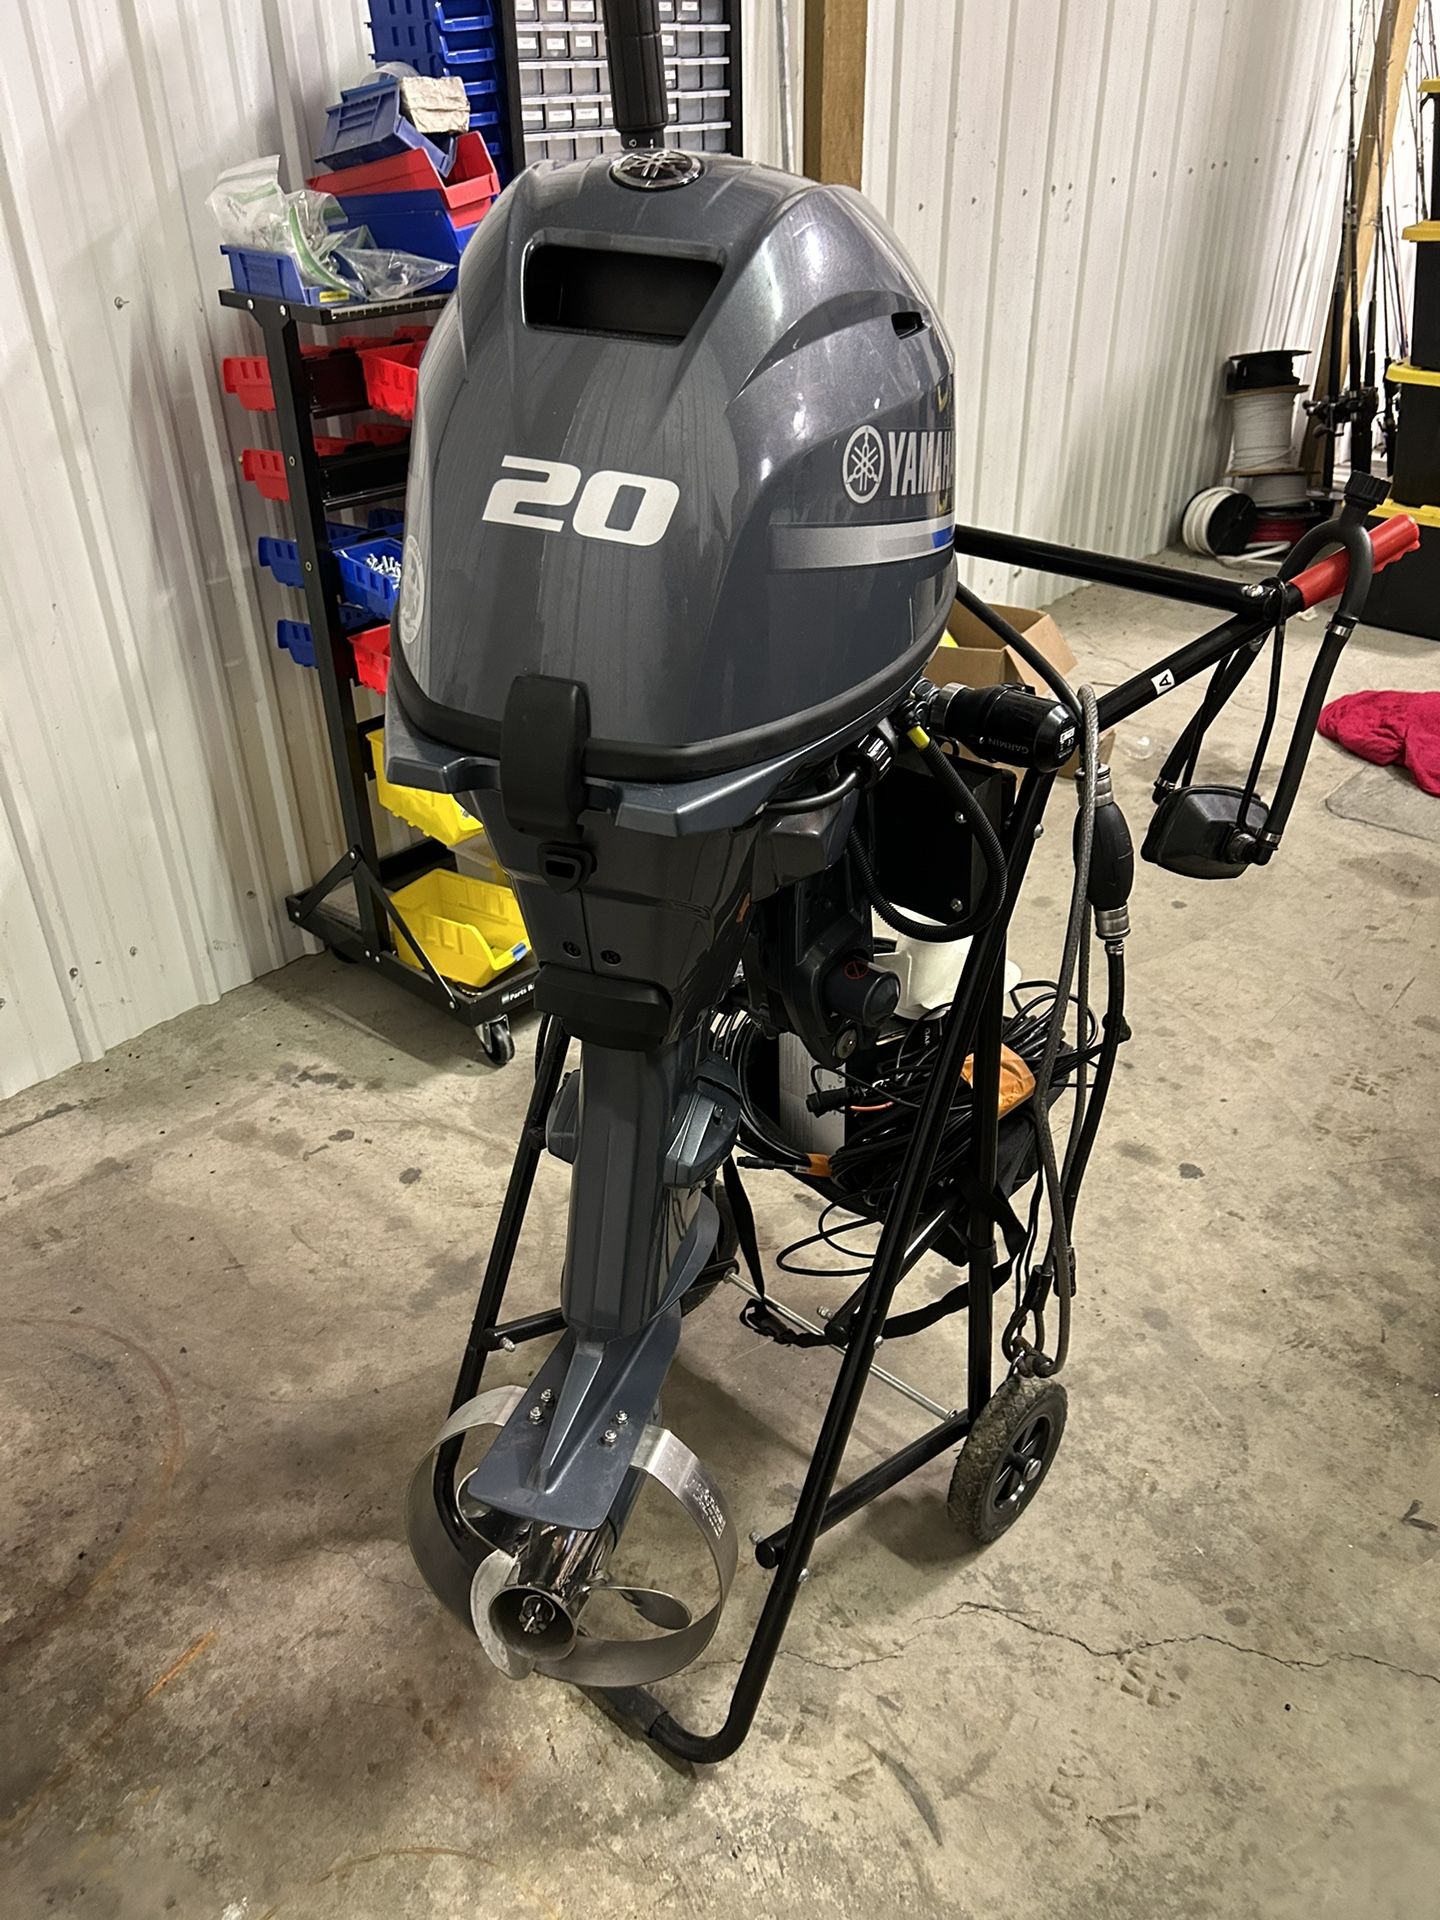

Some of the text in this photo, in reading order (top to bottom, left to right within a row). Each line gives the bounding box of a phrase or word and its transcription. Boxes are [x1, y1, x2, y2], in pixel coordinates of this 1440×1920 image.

[481, 454, 681, 547] 20
[1159, 673, 1172, 687] A
[988, 736, 1029, 755] GARMIN
[510, 988, 527, 1001] Parts
